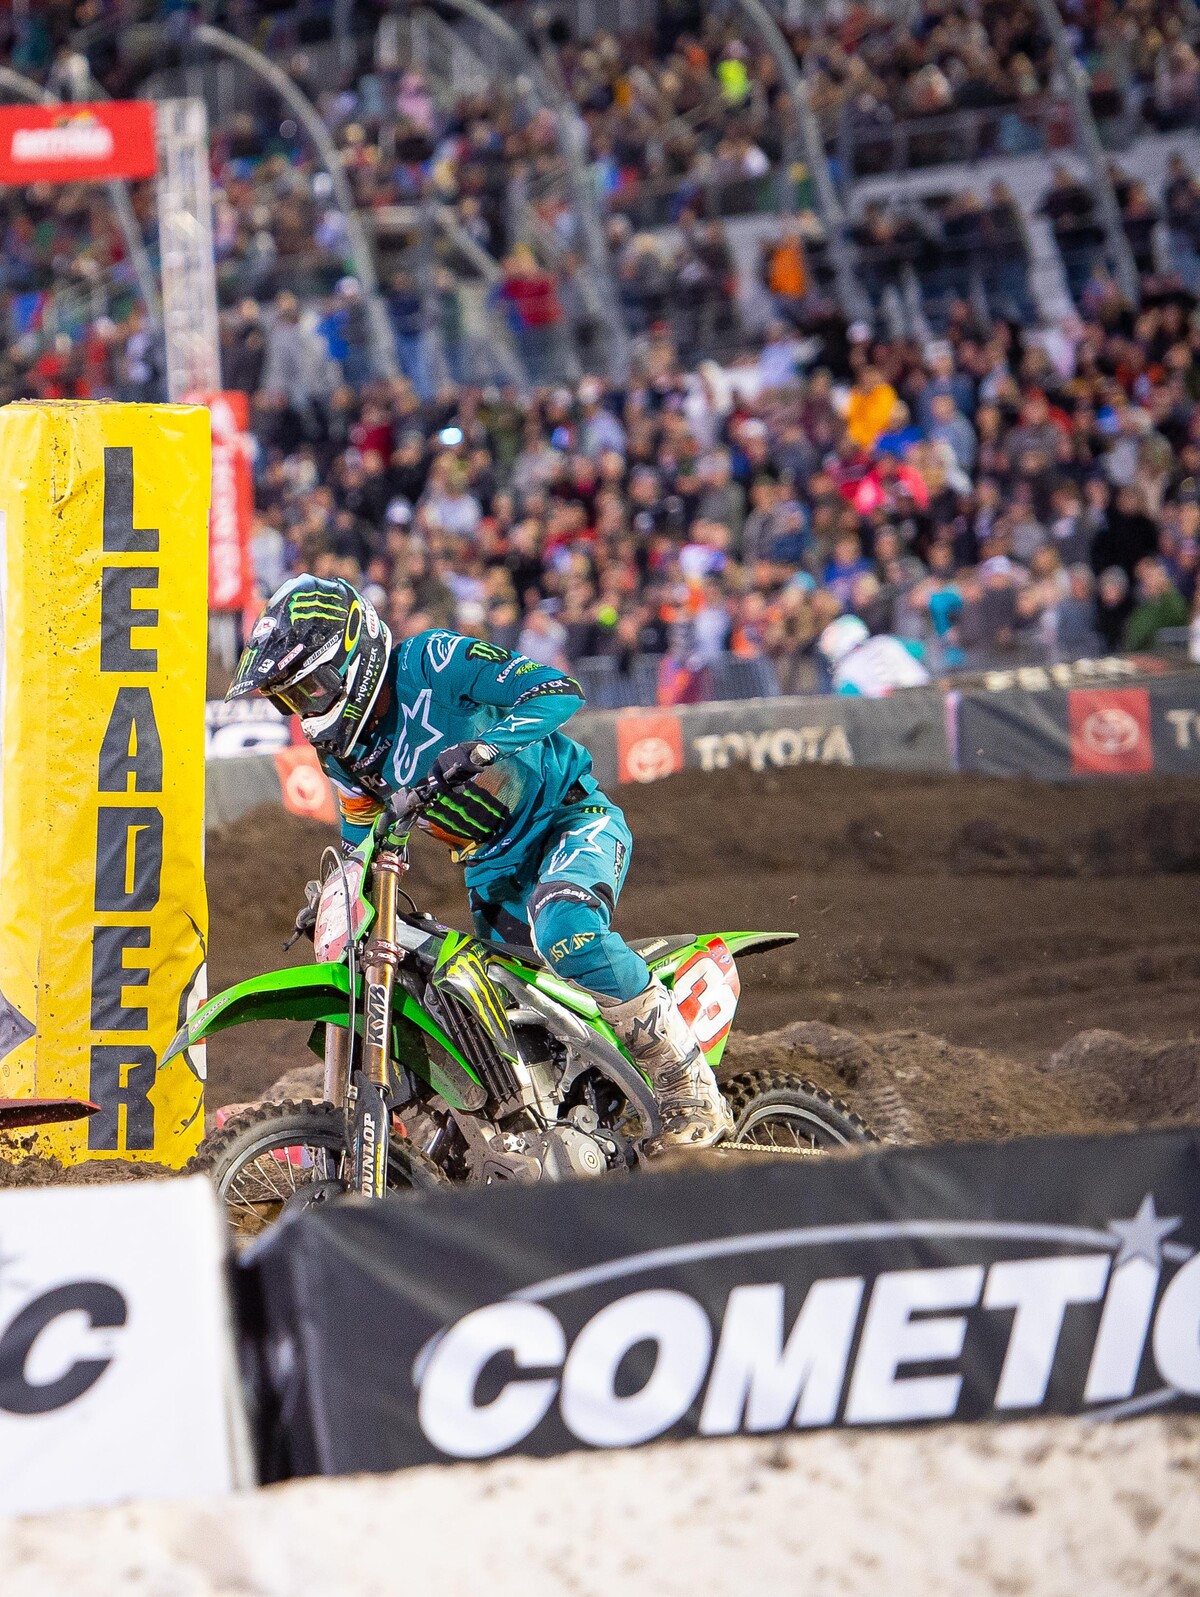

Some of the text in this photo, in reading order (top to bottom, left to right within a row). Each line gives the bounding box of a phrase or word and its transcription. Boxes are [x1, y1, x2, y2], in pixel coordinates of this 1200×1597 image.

[355, 647, 379, 704] MONSTER
[1164, 708, 1200, 748] T
[87, 446, 164, 1151] LEADER
[365, 983, 388, 1048] KYB
[673, 957, 738, 1043] 3
[361, 1112, 377, 1199] DUNLOP
